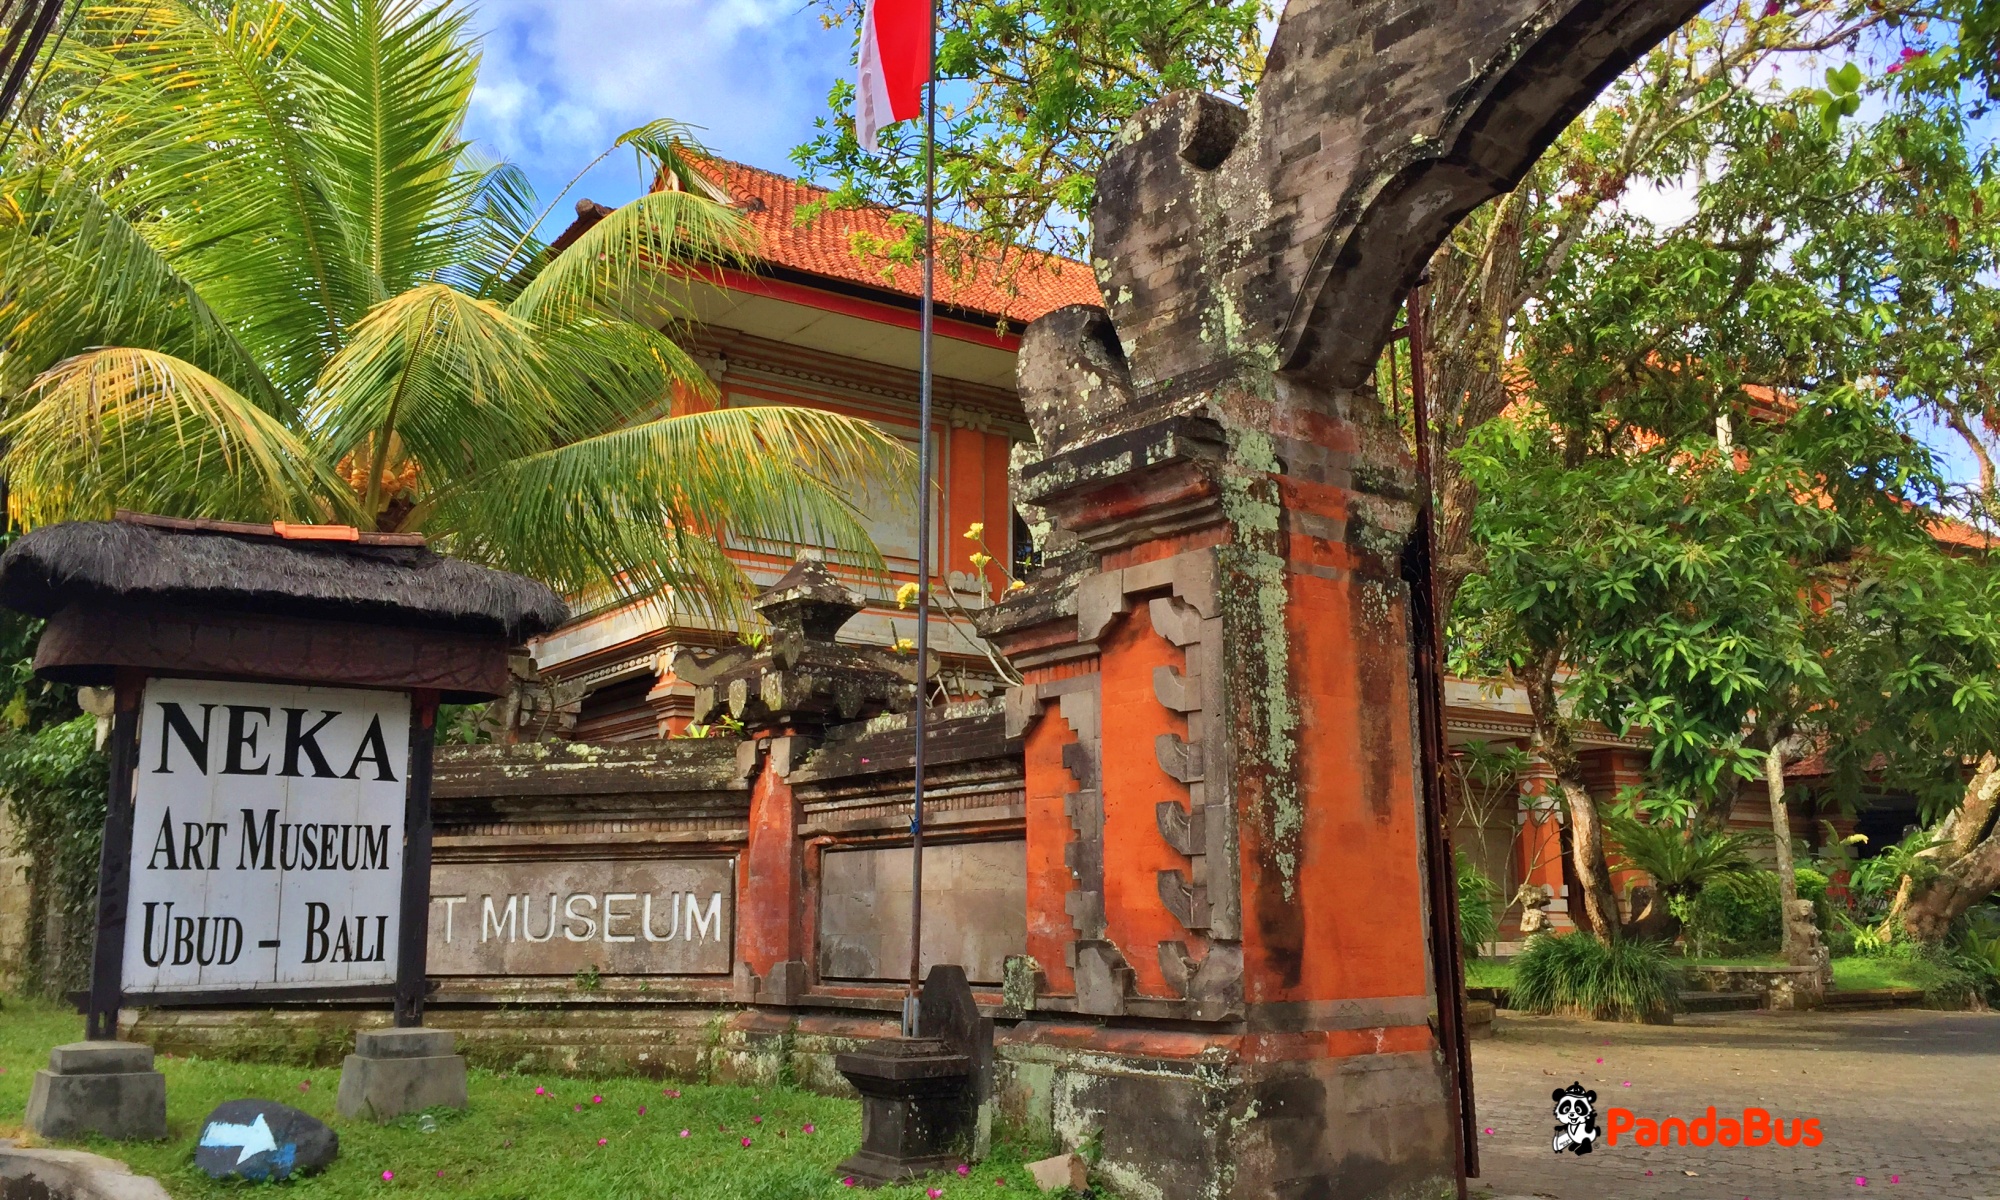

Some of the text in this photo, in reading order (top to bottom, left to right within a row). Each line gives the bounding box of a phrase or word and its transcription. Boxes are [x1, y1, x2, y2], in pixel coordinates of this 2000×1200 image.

[152, 702, 399, 782] NEKA
[147, 806, 391, 871] ART MUSEUM
[142, 902, 244, 967] UBUD
[302, 902, 388, 963] BALI
[480, 891, 722, 945] MUSEUM
